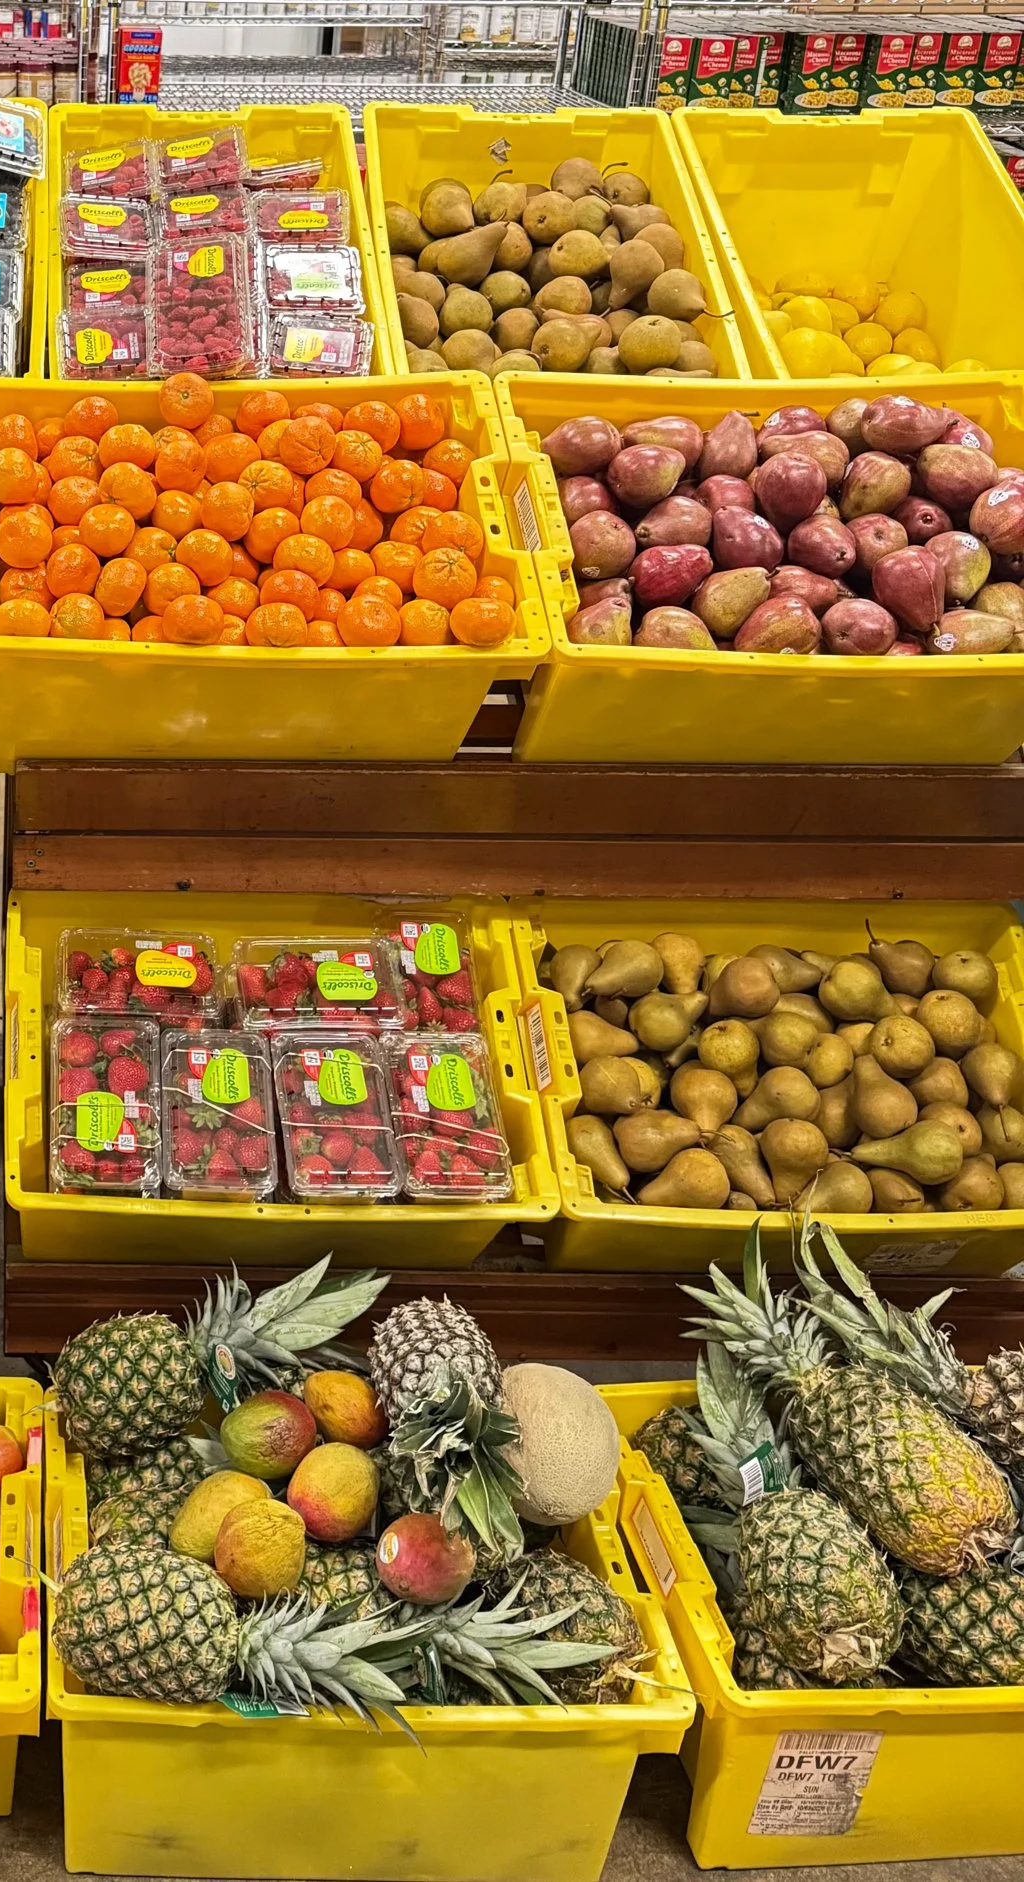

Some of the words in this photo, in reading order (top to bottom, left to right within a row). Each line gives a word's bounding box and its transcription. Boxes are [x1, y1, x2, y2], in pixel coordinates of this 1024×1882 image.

[170, 140, 211, 152] Driscoll's
[82, 152, 123, 165] Driscoll's
[174, 198, 216, 208] Driscoll's
[81, 207, 124, 217] Driscoll's
[85, 274, 127, 283] Driscoll's
[85, 330, 93, 362] Driscoll's
[435, 927, 450, 972] Driscoll's
[141, 969, 193, 979] Driscoll's
[321, 981, 374, 991] Driscoll's
[226, 1054, 240, 1100] Driscoll's
[339, 1053, 357, 1101] Driscoll's
[446, 1058, 465, 1107] Driscoll's
[88, 1096, 99, 1147] Driscoll's
[775, 1755, 858, 1770] DFW7
[777, 1772, 814, 1781] DFW7
[802, 1785, 820, 1794] SUN
